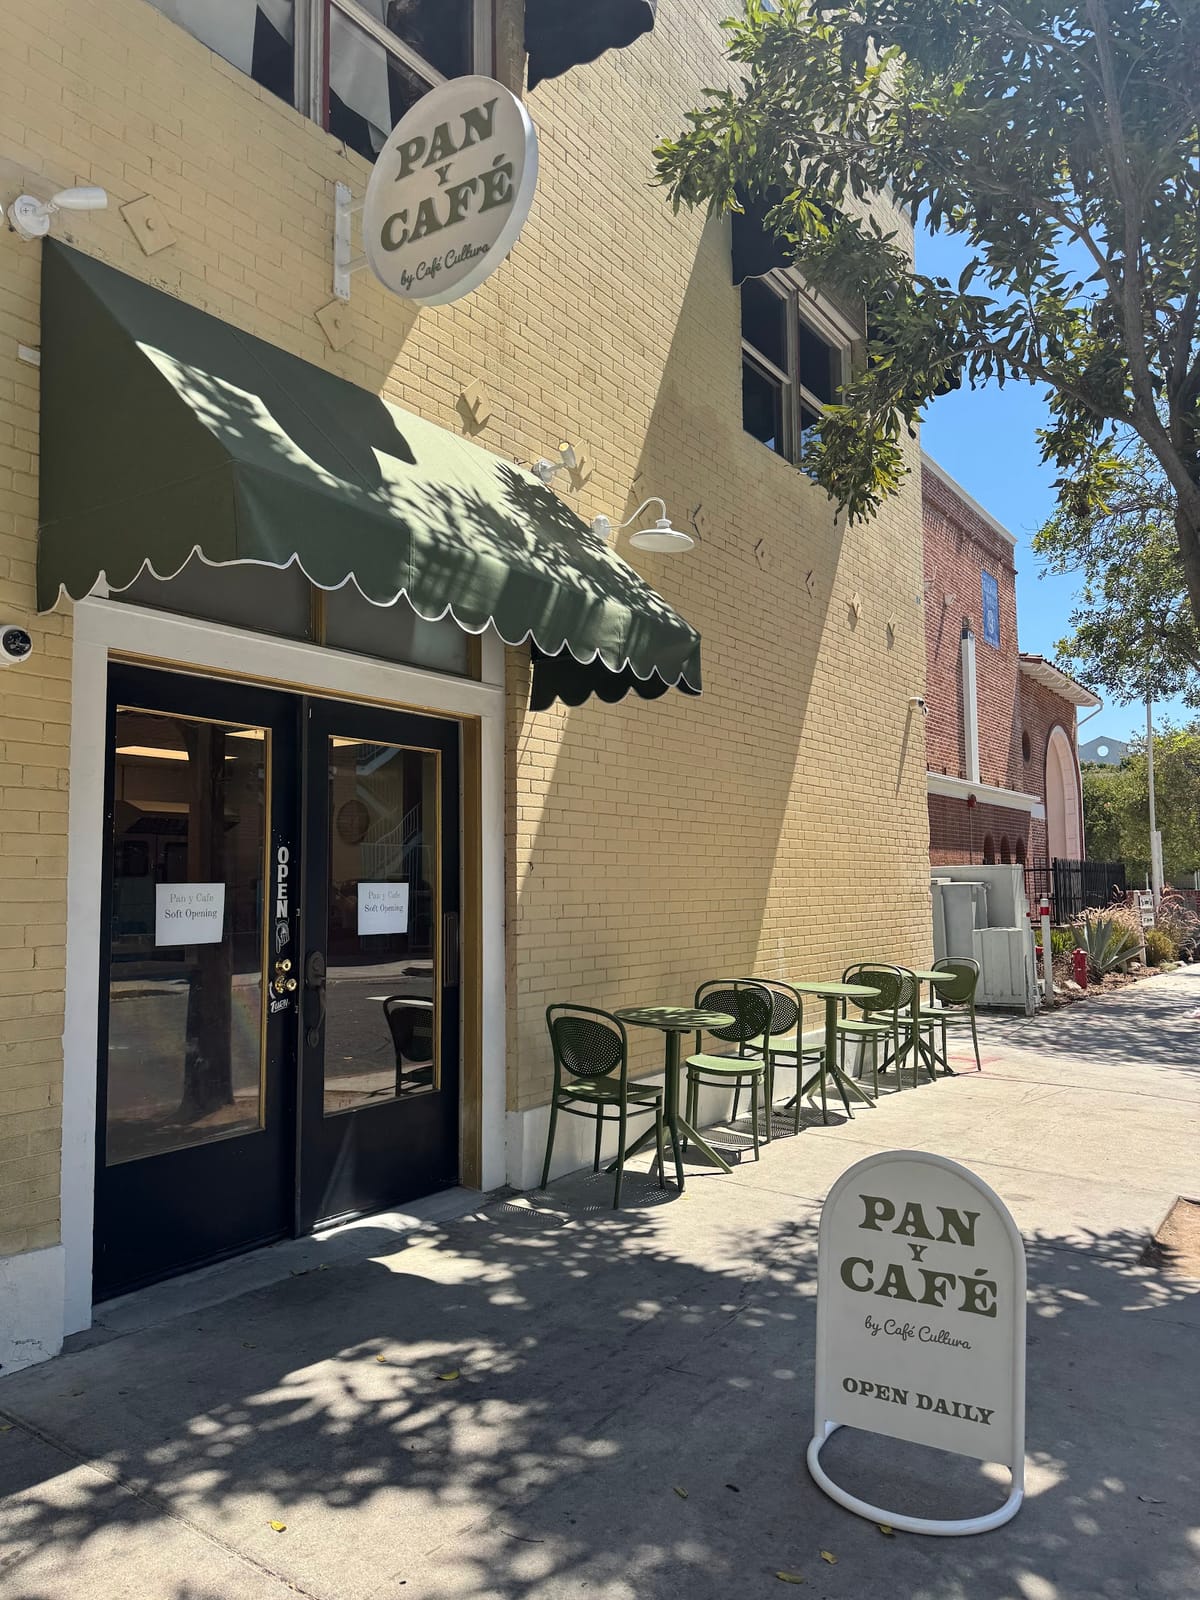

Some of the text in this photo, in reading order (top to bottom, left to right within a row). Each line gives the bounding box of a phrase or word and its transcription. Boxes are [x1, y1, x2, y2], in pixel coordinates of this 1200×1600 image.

[394, 97, 498, 182] PAN
[434, 162, 453, 186] Y
[380, 153, 514, 252] CAFÉ
[400, 242, 490, 291] by Café Cultura
[170, 893, 186, 903] Pan
[188, 895, 194, 904] y
[276, 846, 290, 918] OPEN
[368, 890, 380, 900] Pan
[164, 908, 218, 920] Soft Opening
[364, 903, 404, 914] Soft Opening
[858, 1194, 981, 1247] PAN
[907, 1242, 928, 1262] Y
[840, 1256, 998, 1318] CAFÉ
[864, 1315, 972, 1350] by Café Cultura
[842, 1377, 995, 1426] OPEN DAILY
